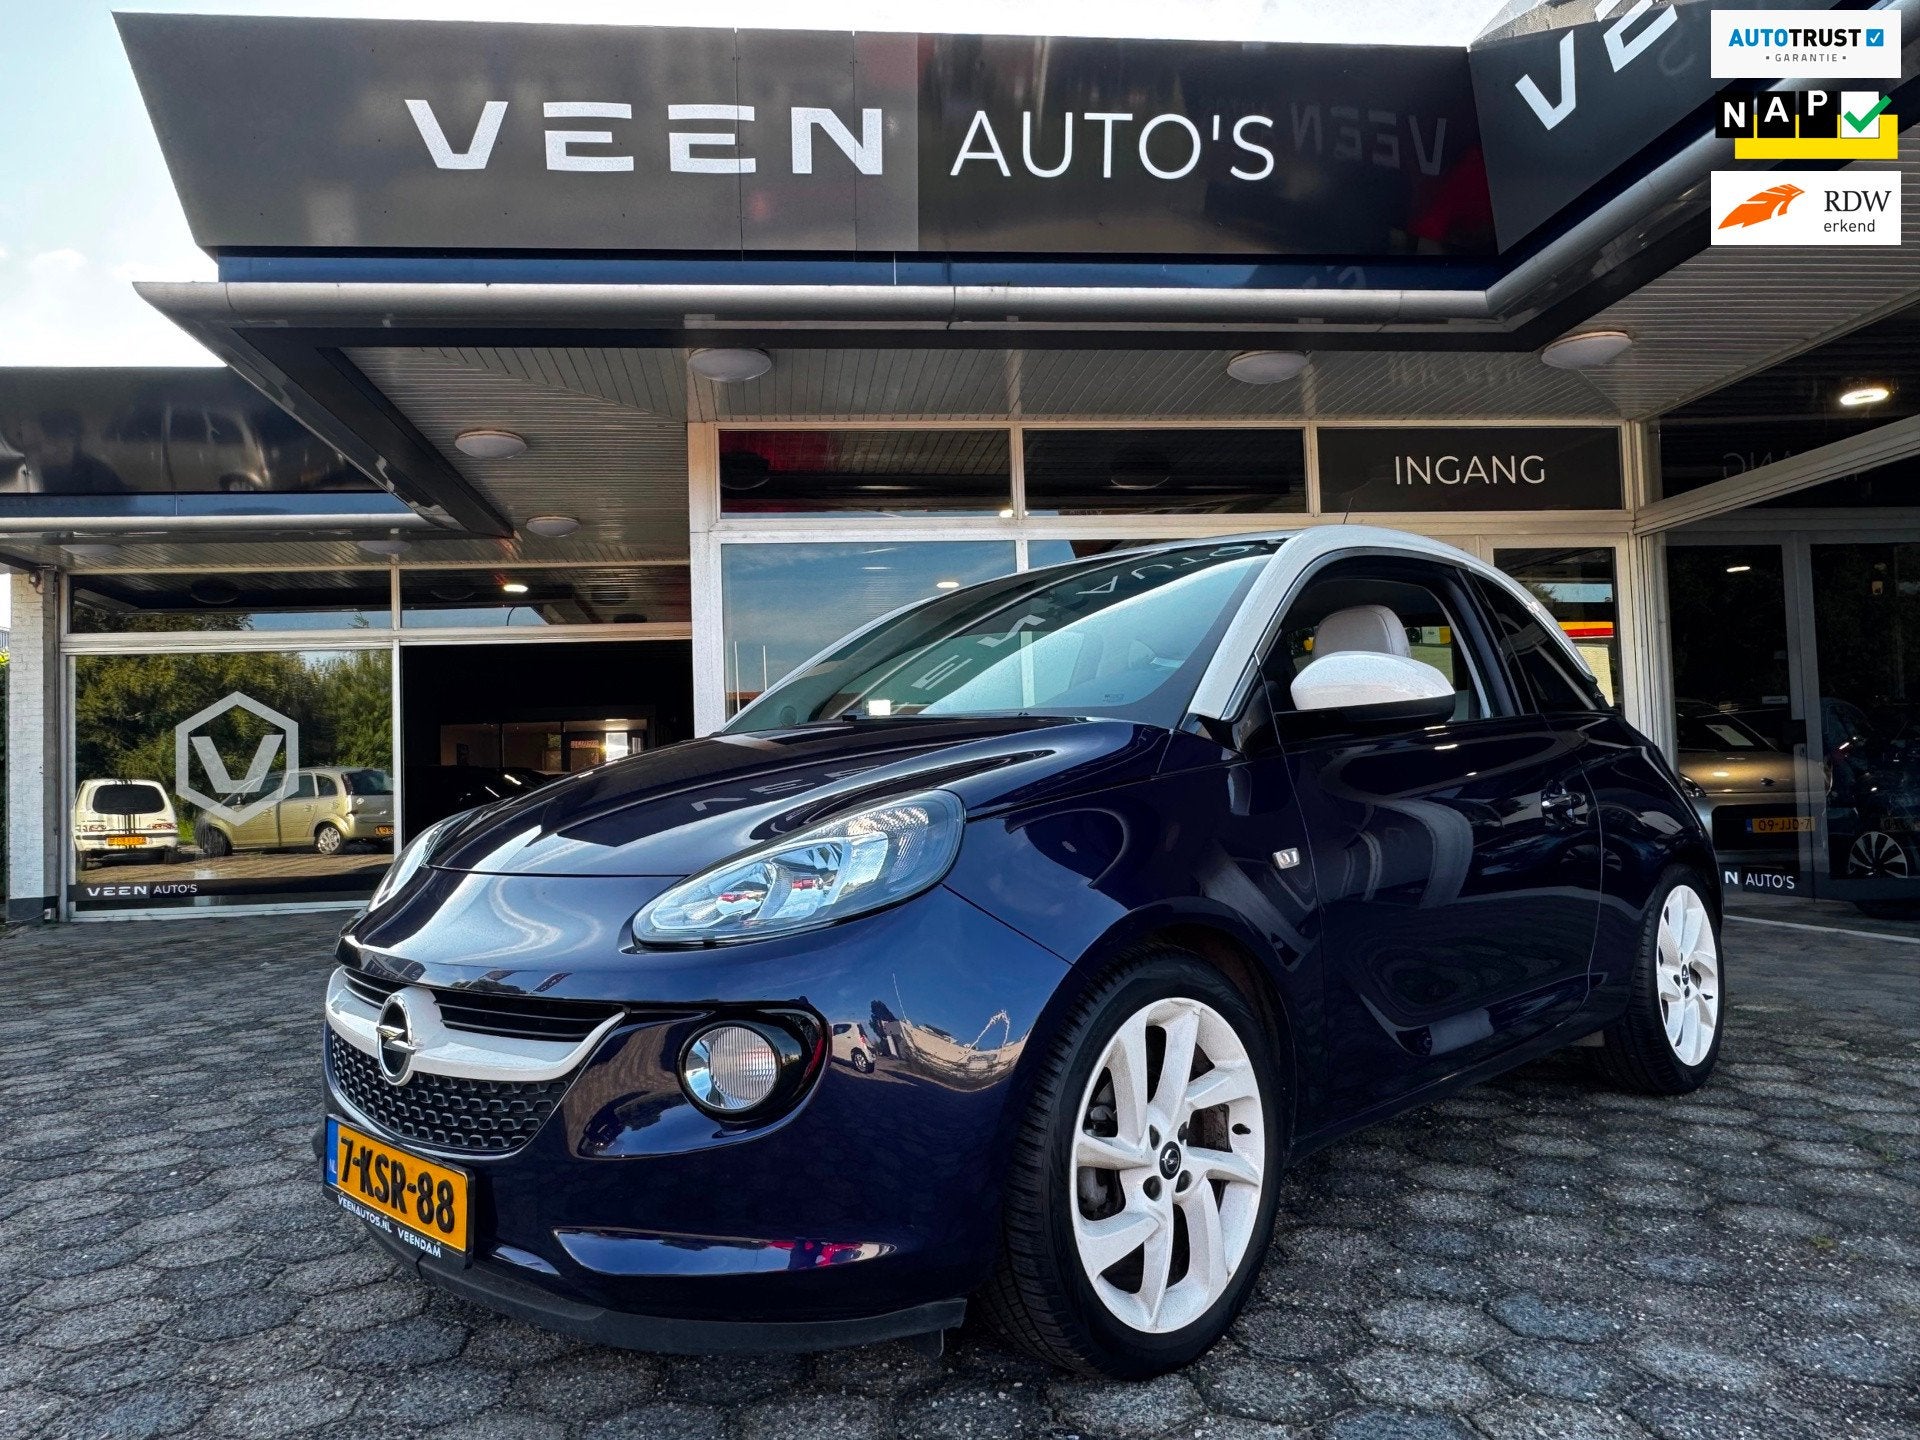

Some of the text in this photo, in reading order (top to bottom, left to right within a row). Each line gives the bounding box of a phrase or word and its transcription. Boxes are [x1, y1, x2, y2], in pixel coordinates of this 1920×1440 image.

[404, 99, 1275, 181] VEEN AUTO'S
[1395, 455, 1546, 485] INGANG
[86, 883, 198, 897] VEEN AUTO'S
[1745, 873, 1795, 890] AUTO'S
[340, 1136, 456, 1234] 7-KSR-88
[397, 1227, 442, 1258] VEENDAM
